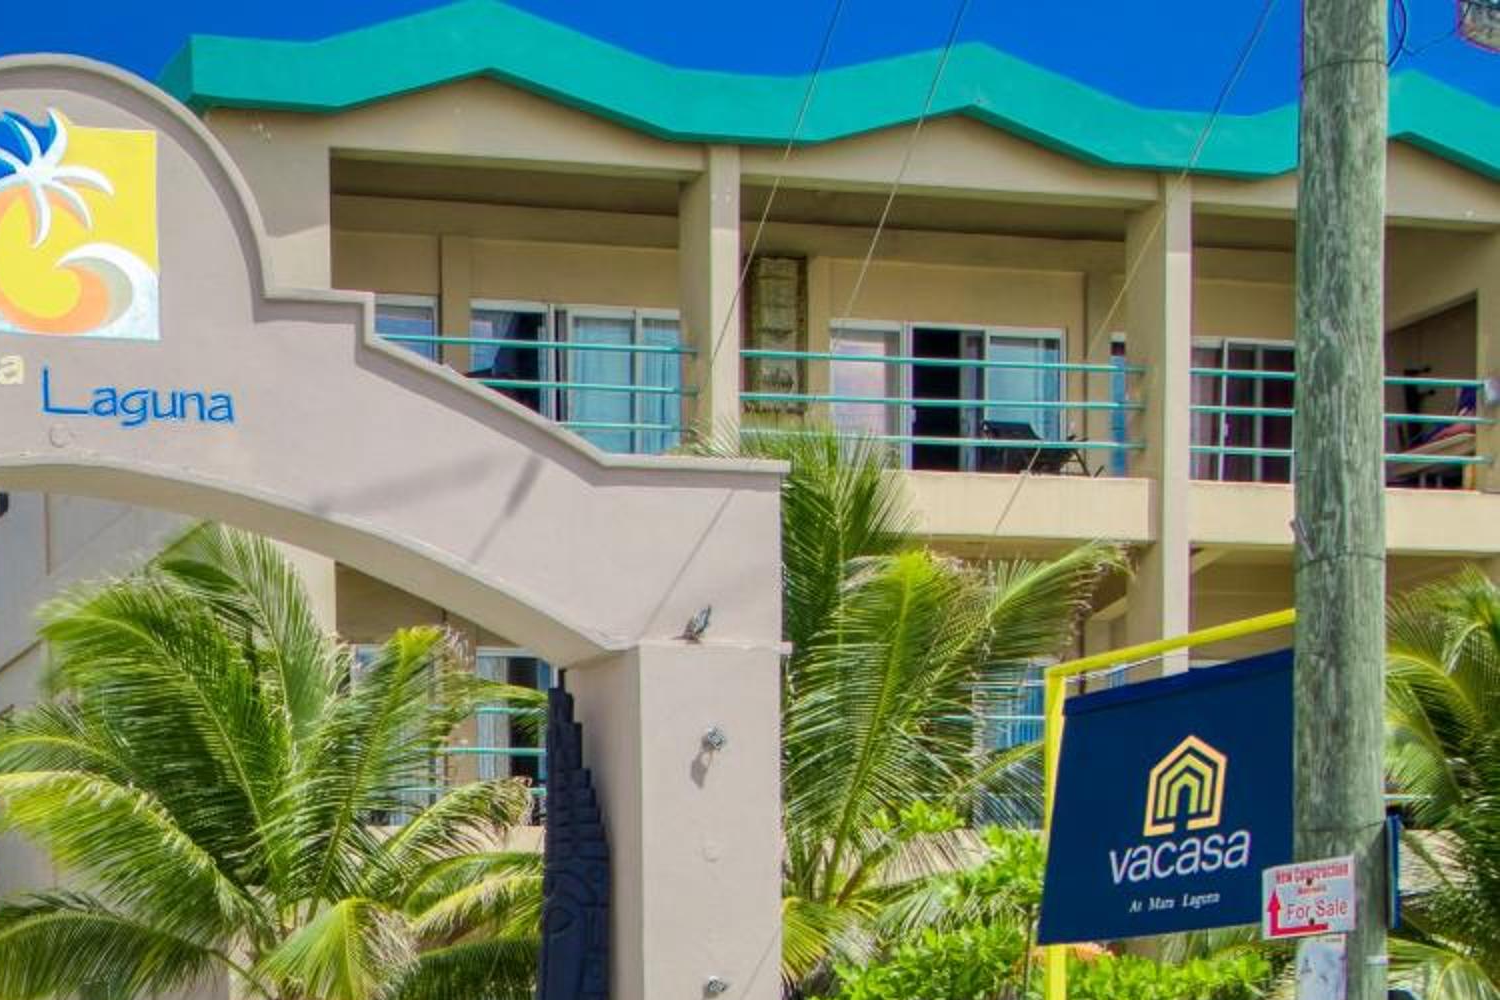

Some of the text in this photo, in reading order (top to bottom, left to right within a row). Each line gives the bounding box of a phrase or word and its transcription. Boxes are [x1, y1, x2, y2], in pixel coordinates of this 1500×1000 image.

[41, 366, 235, 427] Laguna
[1109, 830, 1252, 885] vacasa
[1287, 898, 1349, 921] For Sale
